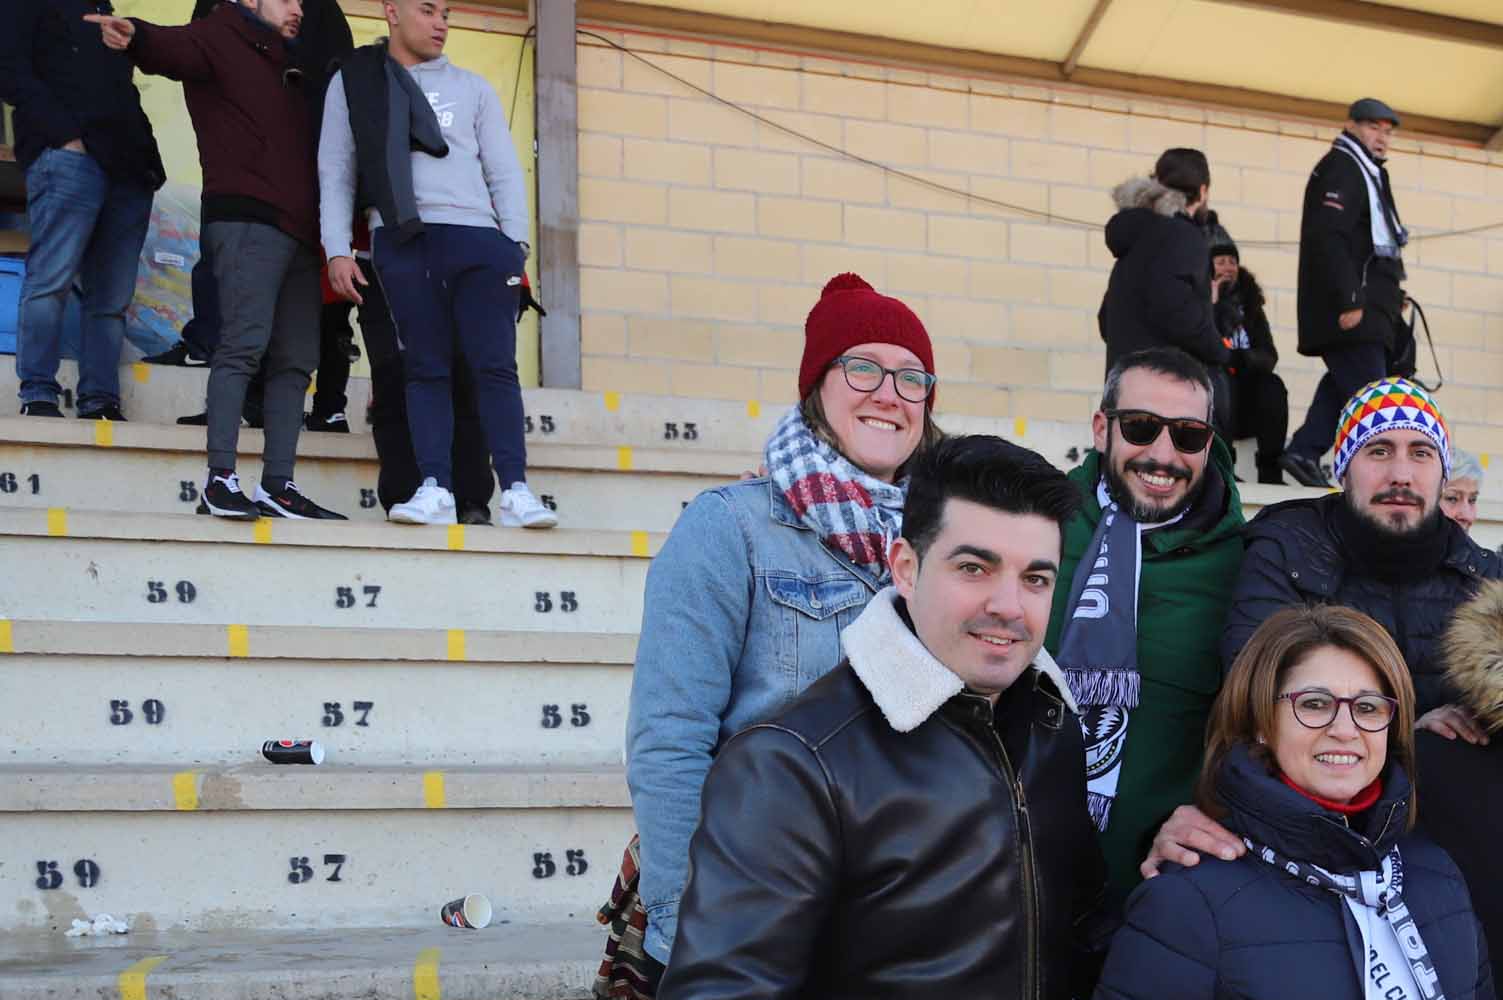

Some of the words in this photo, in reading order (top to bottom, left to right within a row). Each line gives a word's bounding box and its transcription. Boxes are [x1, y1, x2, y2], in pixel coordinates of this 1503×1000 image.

[664, 422, 698, 441] 53
[0, 472, 41, 495] 61
[146, 580, 197, 604] 59
[335, 585, 382, 609] 57
[533, 591, 579, 613] 55
[109, 698, 166, 726] 59
[321, 700, 375, 728] 57
[540, 703, 591, 729] 55
[35, 858, 101, 890] 59
[287, 853, 347, 885] 57
[532, 848, 589, 880] 55
[1368, 961, 1383, 989] EL
